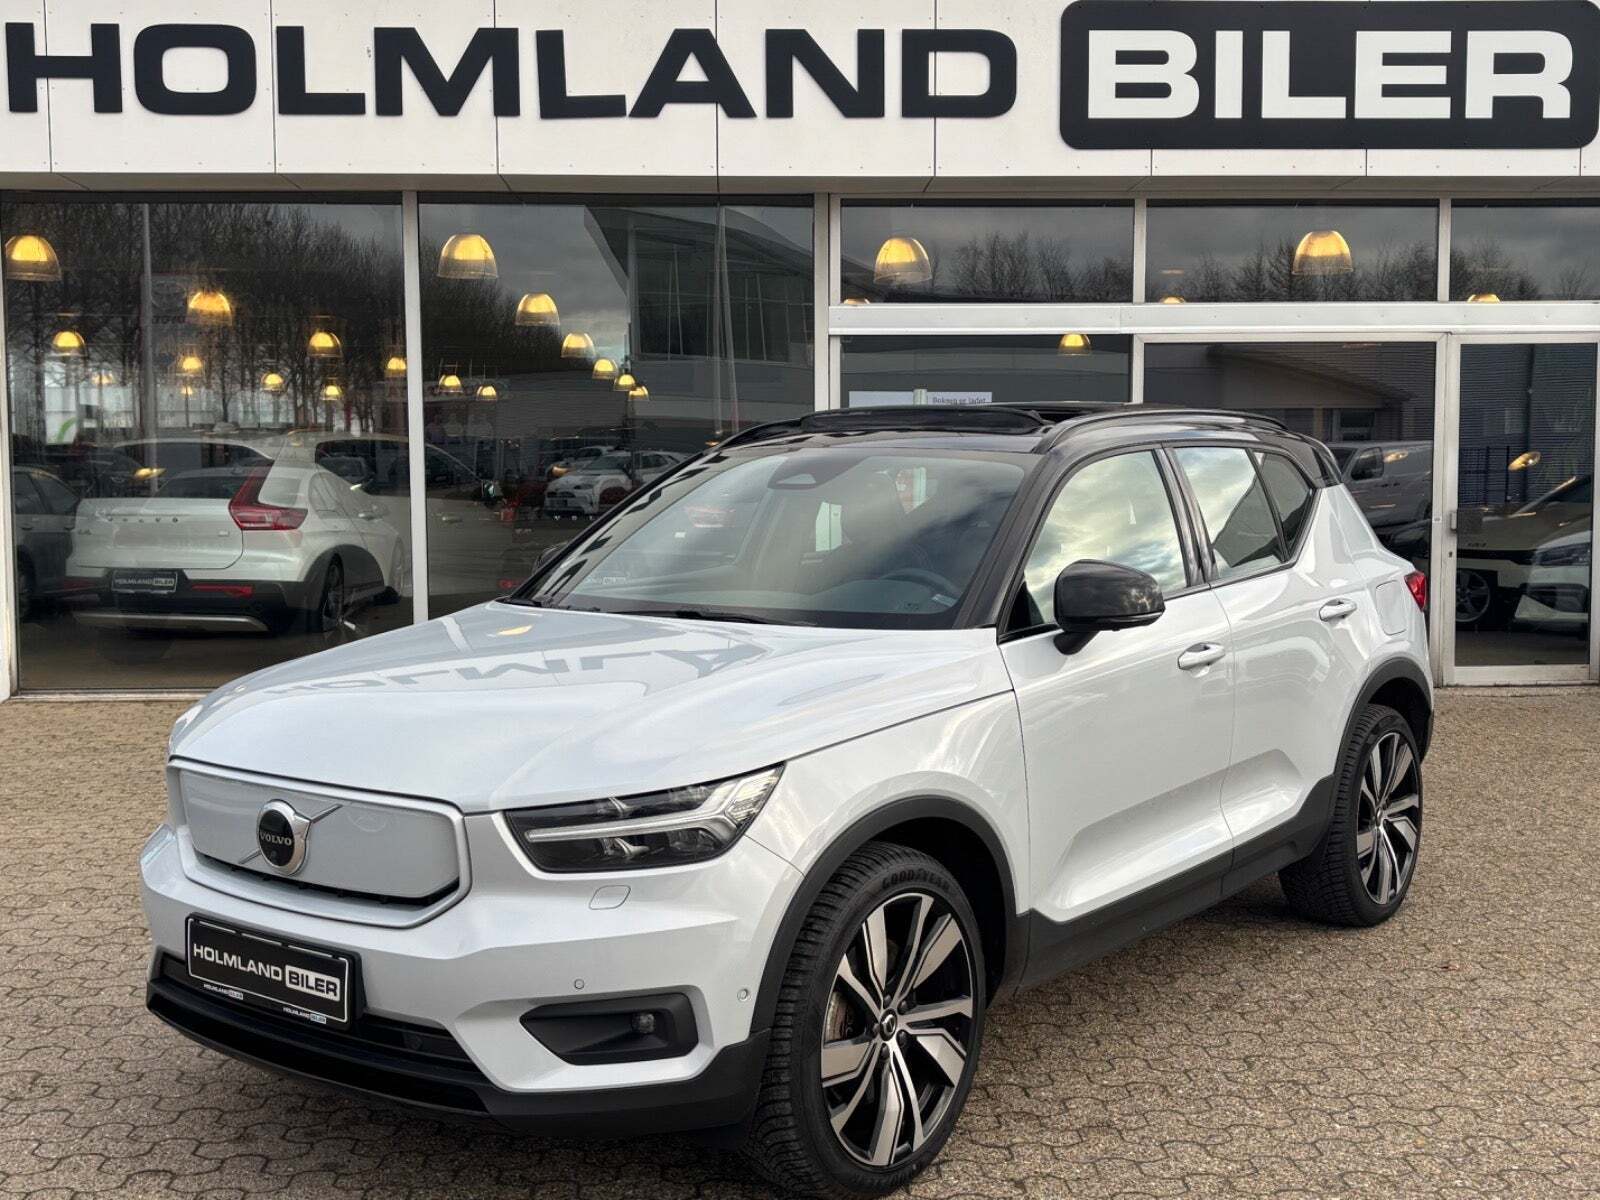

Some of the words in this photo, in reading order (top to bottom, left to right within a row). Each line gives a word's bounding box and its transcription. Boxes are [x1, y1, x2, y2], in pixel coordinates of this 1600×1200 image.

[5, 22, 1018, 120] HOLMLAND
[1087, 29, 1574, 120] BILER
[259, 831, 293, 846] VOLVO
[193, 943, 283, 982] HOLMLAND
[288, 970, 338, 997] BILER
